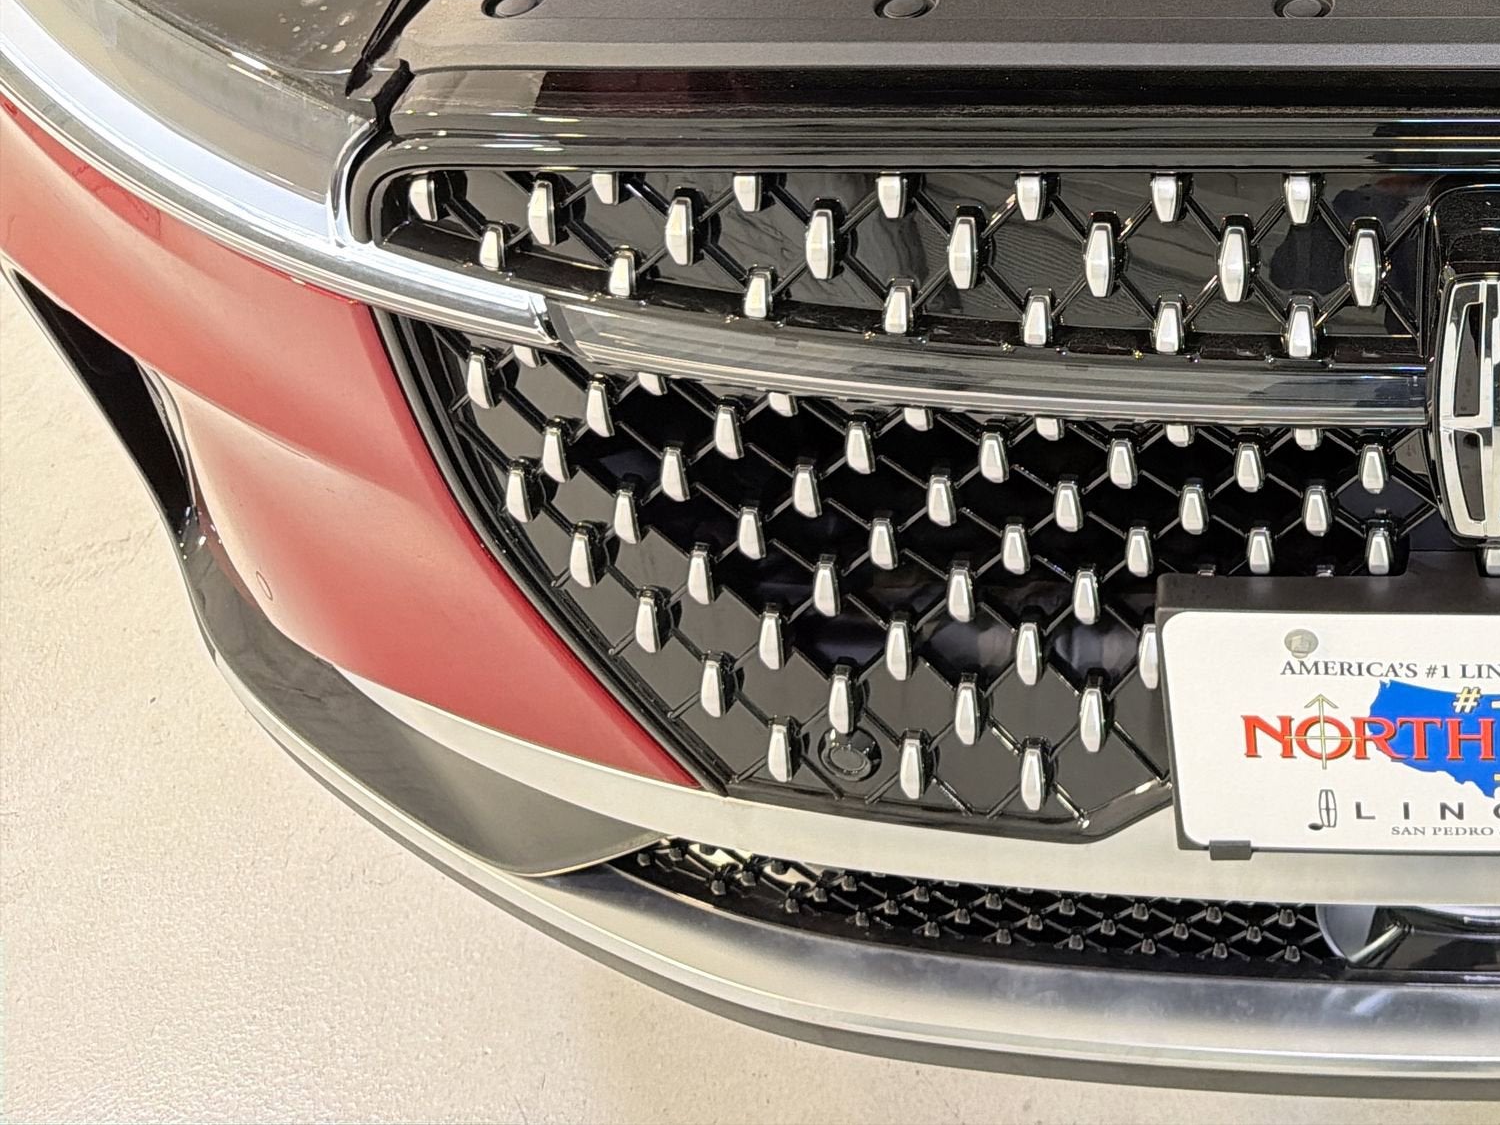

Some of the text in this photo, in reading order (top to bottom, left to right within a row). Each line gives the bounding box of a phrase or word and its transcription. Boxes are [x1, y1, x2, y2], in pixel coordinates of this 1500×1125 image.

[1280, 660, 1419, 679] AMERICA'S
[1426, 665, 1451, 680] #1
[1241, 715, 1497, 762] NORTH
[1391, 826, 1427, 836] SAN
[1432, 826, 1495, 836] PEDRO
